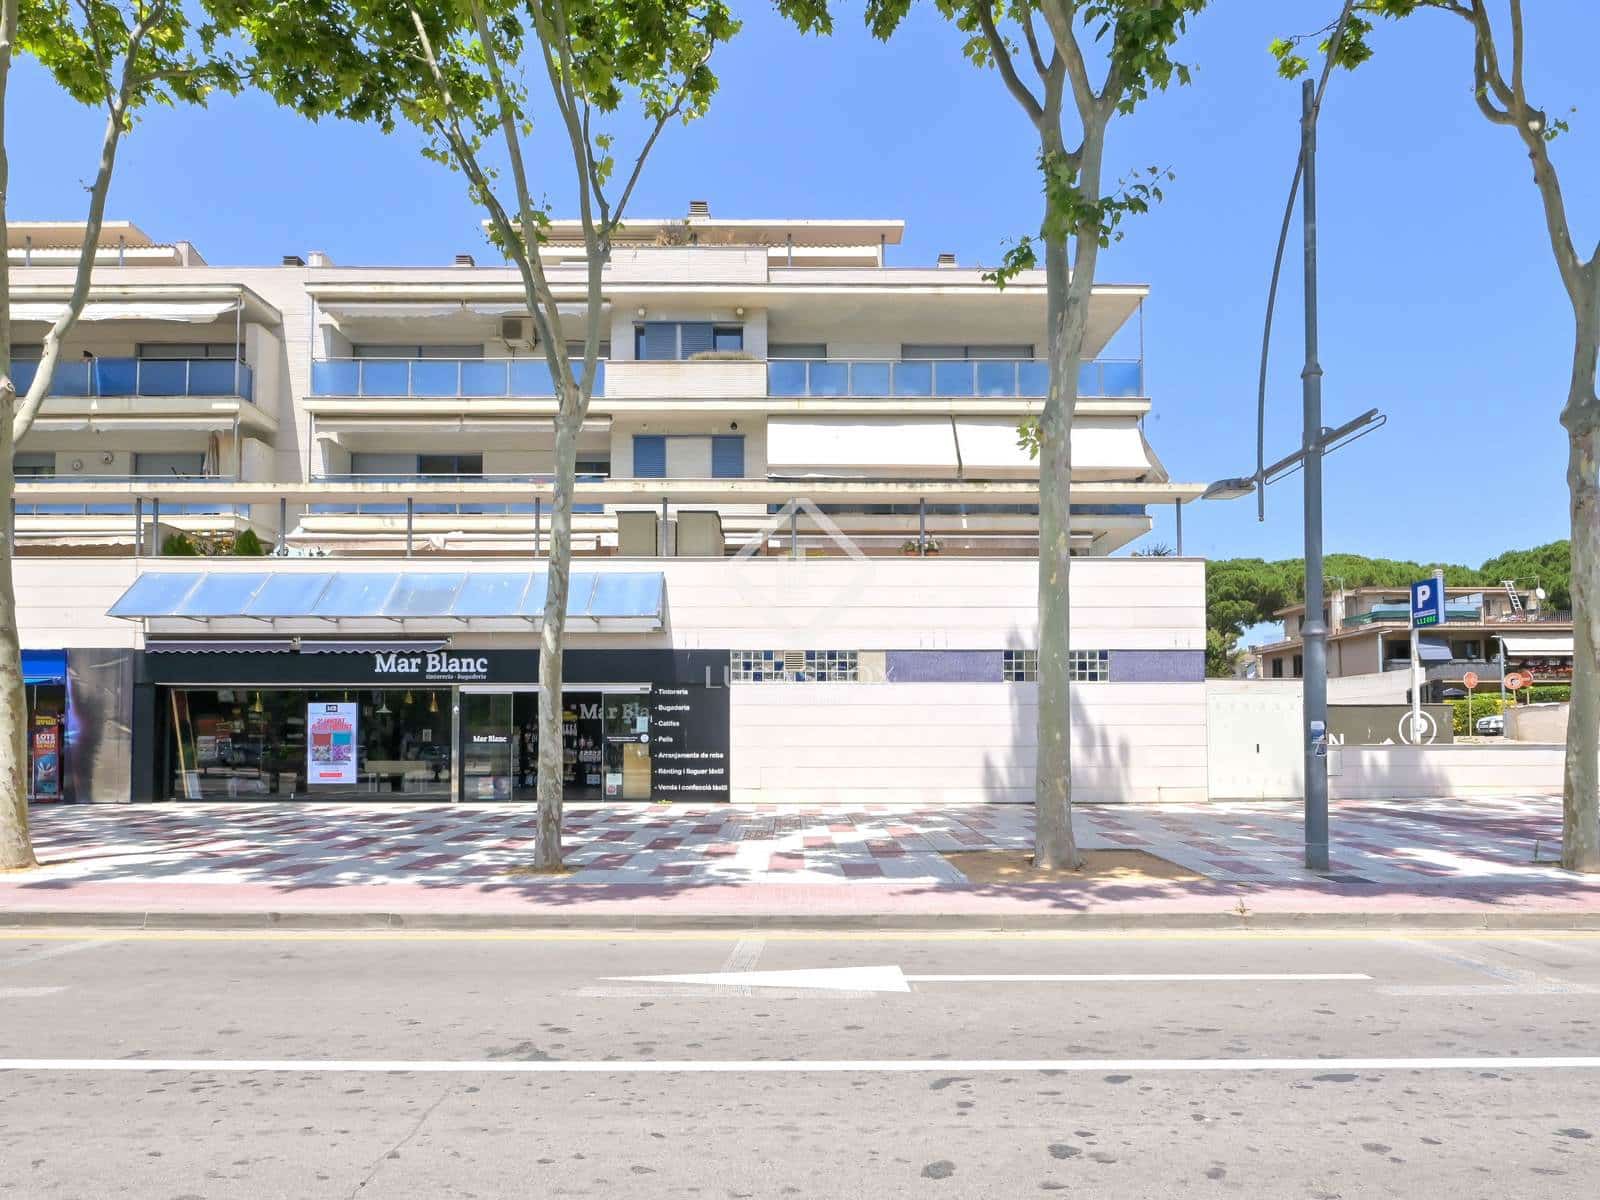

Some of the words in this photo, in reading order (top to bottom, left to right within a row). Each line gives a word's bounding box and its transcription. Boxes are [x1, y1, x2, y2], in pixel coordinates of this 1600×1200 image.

[1417, 585, 1430, 608] P
[375, 653, 421, 673] Mar
[426, 652, 488, 673] Blanc
[580, 703, 618, 719] Mar
